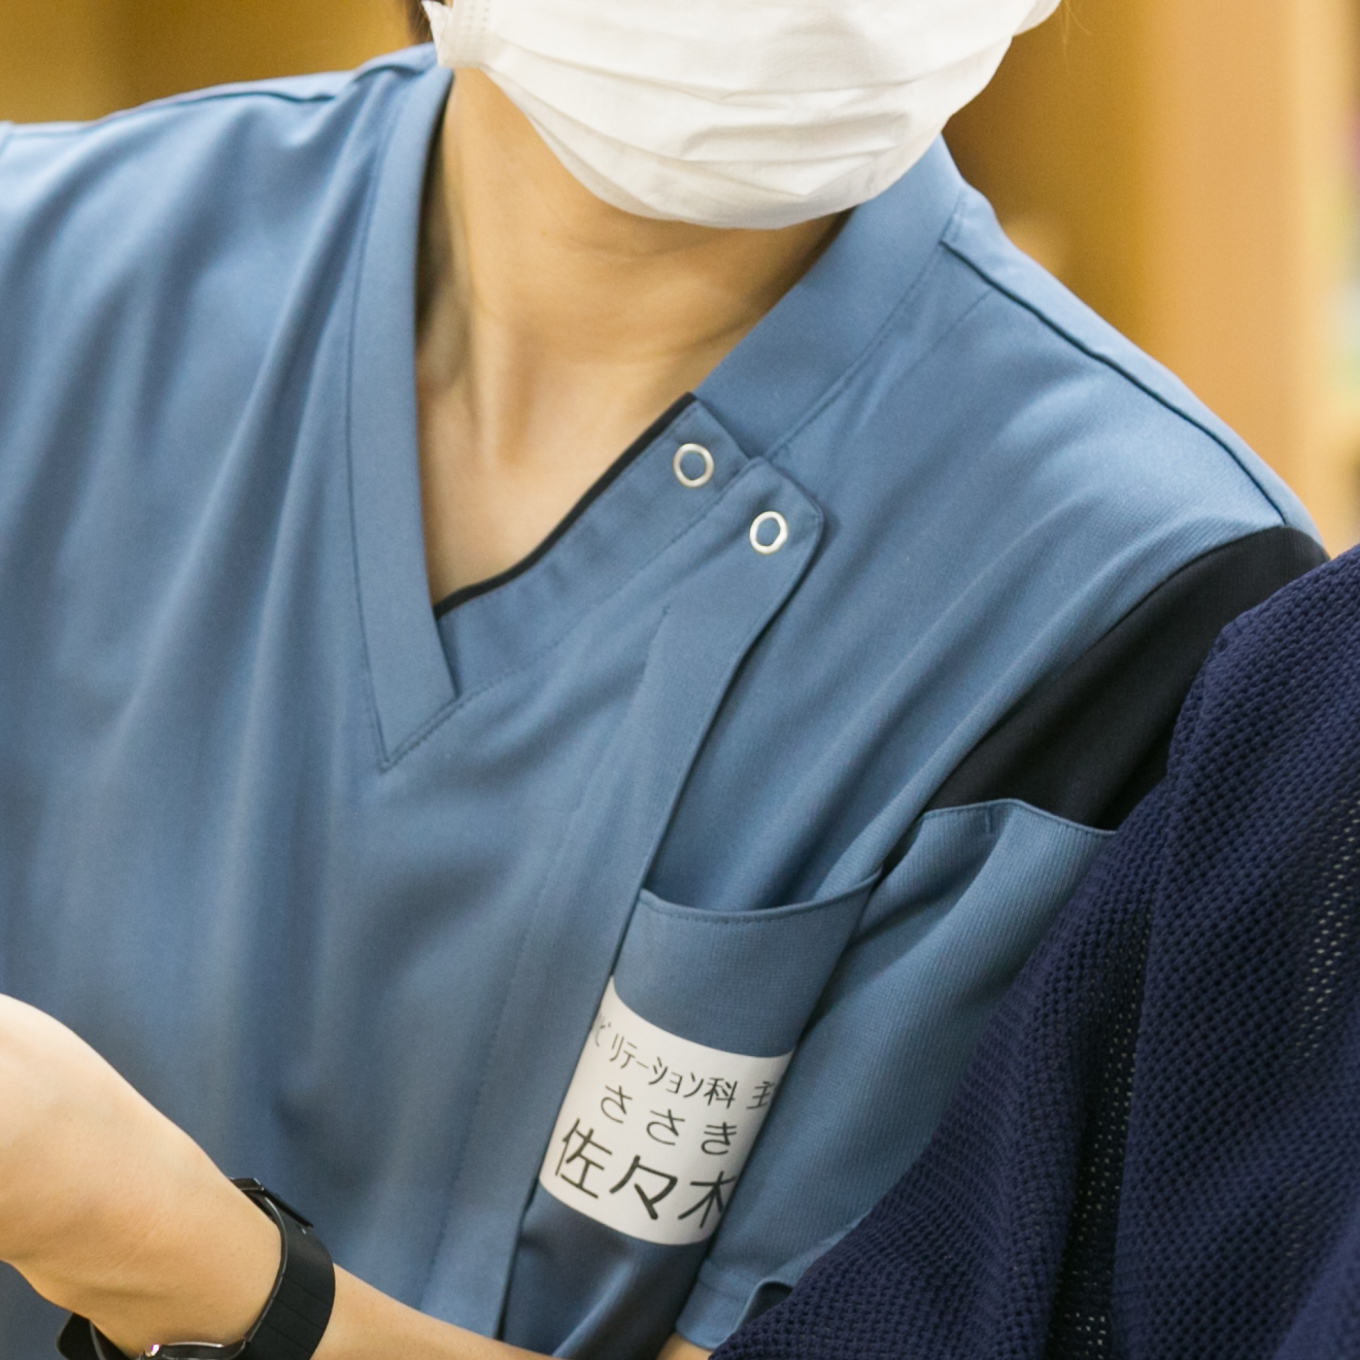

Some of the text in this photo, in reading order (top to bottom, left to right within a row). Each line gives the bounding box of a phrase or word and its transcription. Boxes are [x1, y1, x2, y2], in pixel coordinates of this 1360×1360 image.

[600, 1085, 737, 1156] ささき
[554, 1118, 738, 1229] 佐々木
